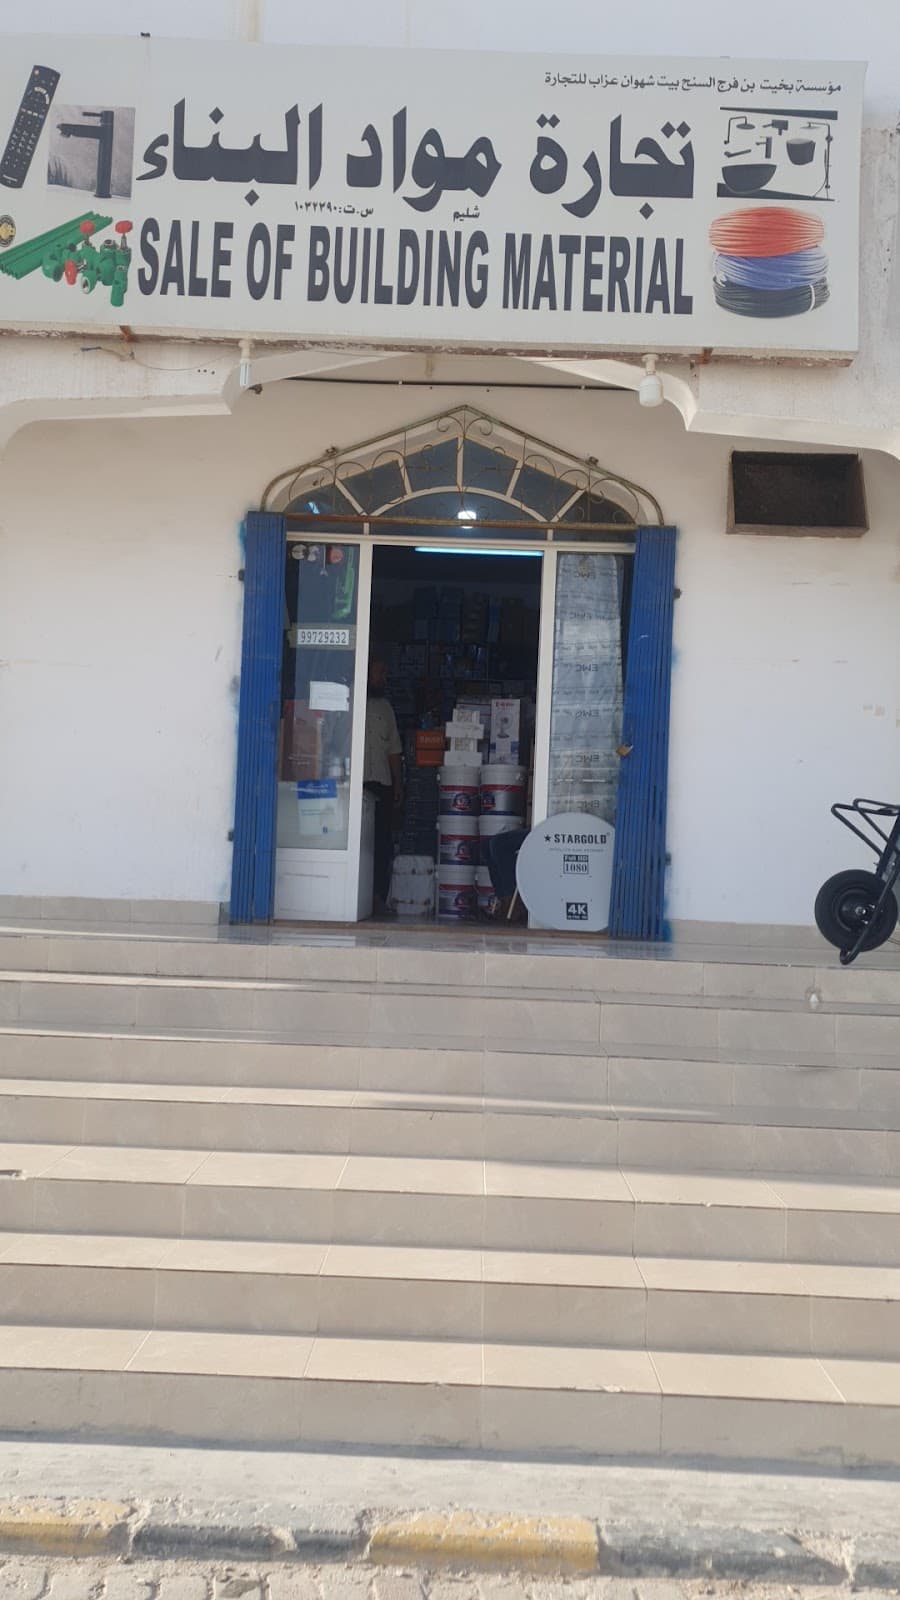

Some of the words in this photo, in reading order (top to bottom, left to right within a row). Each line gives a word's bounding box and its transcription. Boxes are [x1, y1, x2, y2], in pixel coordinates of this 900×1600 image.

[544, 71, 587, 88] للتجارة
[588, 72, 618, 88] عزاب
[620, 74, 655, 89] شهوان
[657, 75, 680, 90] بيت
[717, 76, 739, 93] فرج
[740, 78, 756, 93] بن
[760, 79, 794, 94] بخيت
[796, 79, 842, 95] مؤسسة
[136, 97, 323, 206] البناء
[346, 105, 502, 213] مواد
[529, 113, 695, 220] تجارة
[137, 217, 234, 298] SALE
[246, 222, 296, 301] OF
[306, 225, 489, 309] BUILDING
[502, 232, 693, 315] MATERIAL
[554, 833, 607, 844] STARGOLD
[565, 863, 588, 872] 1080
[567, 904, 587, 915] 4K
